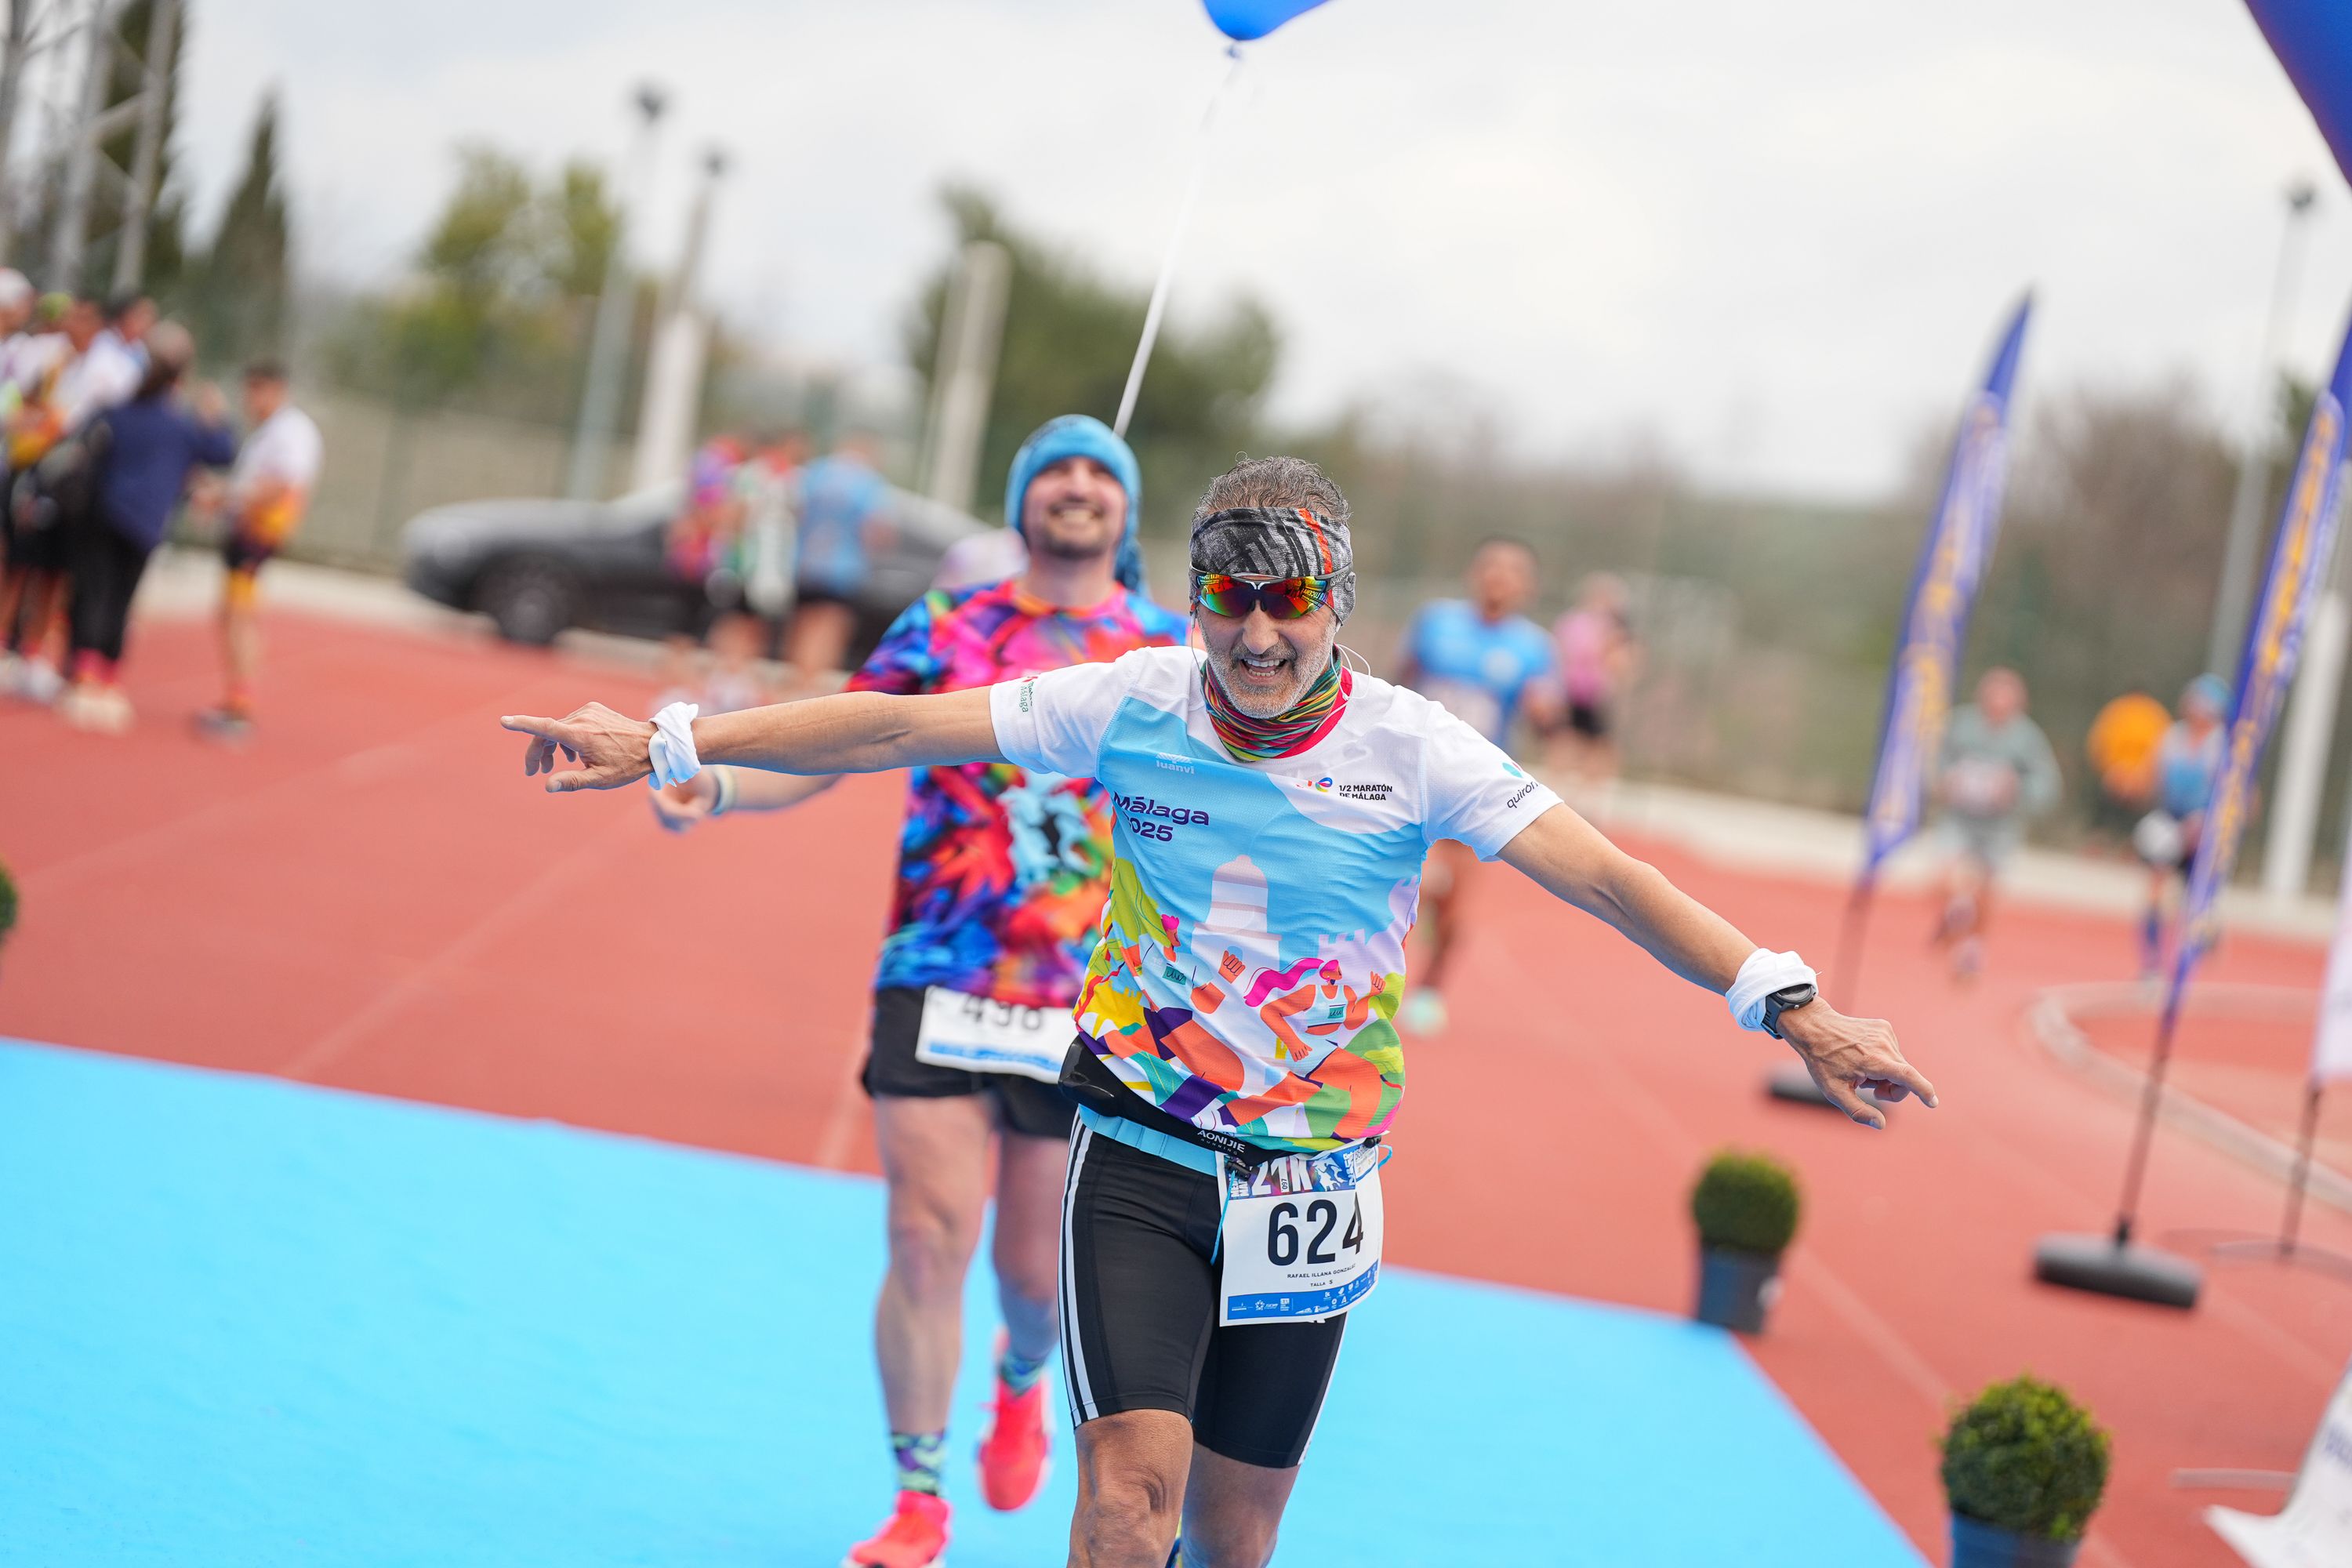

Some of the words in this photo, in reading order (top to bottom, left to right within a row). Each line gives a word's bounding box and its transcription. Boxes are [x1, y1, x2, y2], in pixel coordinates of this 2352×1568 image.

[1352, 793, 1386, 801] MÁLAGA
[1353, 784, 1392, 793] MARATÓN
[1113, 790, 1210, 826] Málaga
[1124, 813, 1174, 843] 025
[1197, 1130, 1246, 1153] AONIJIE
[1268, 1192, 1364, 1266] 624
